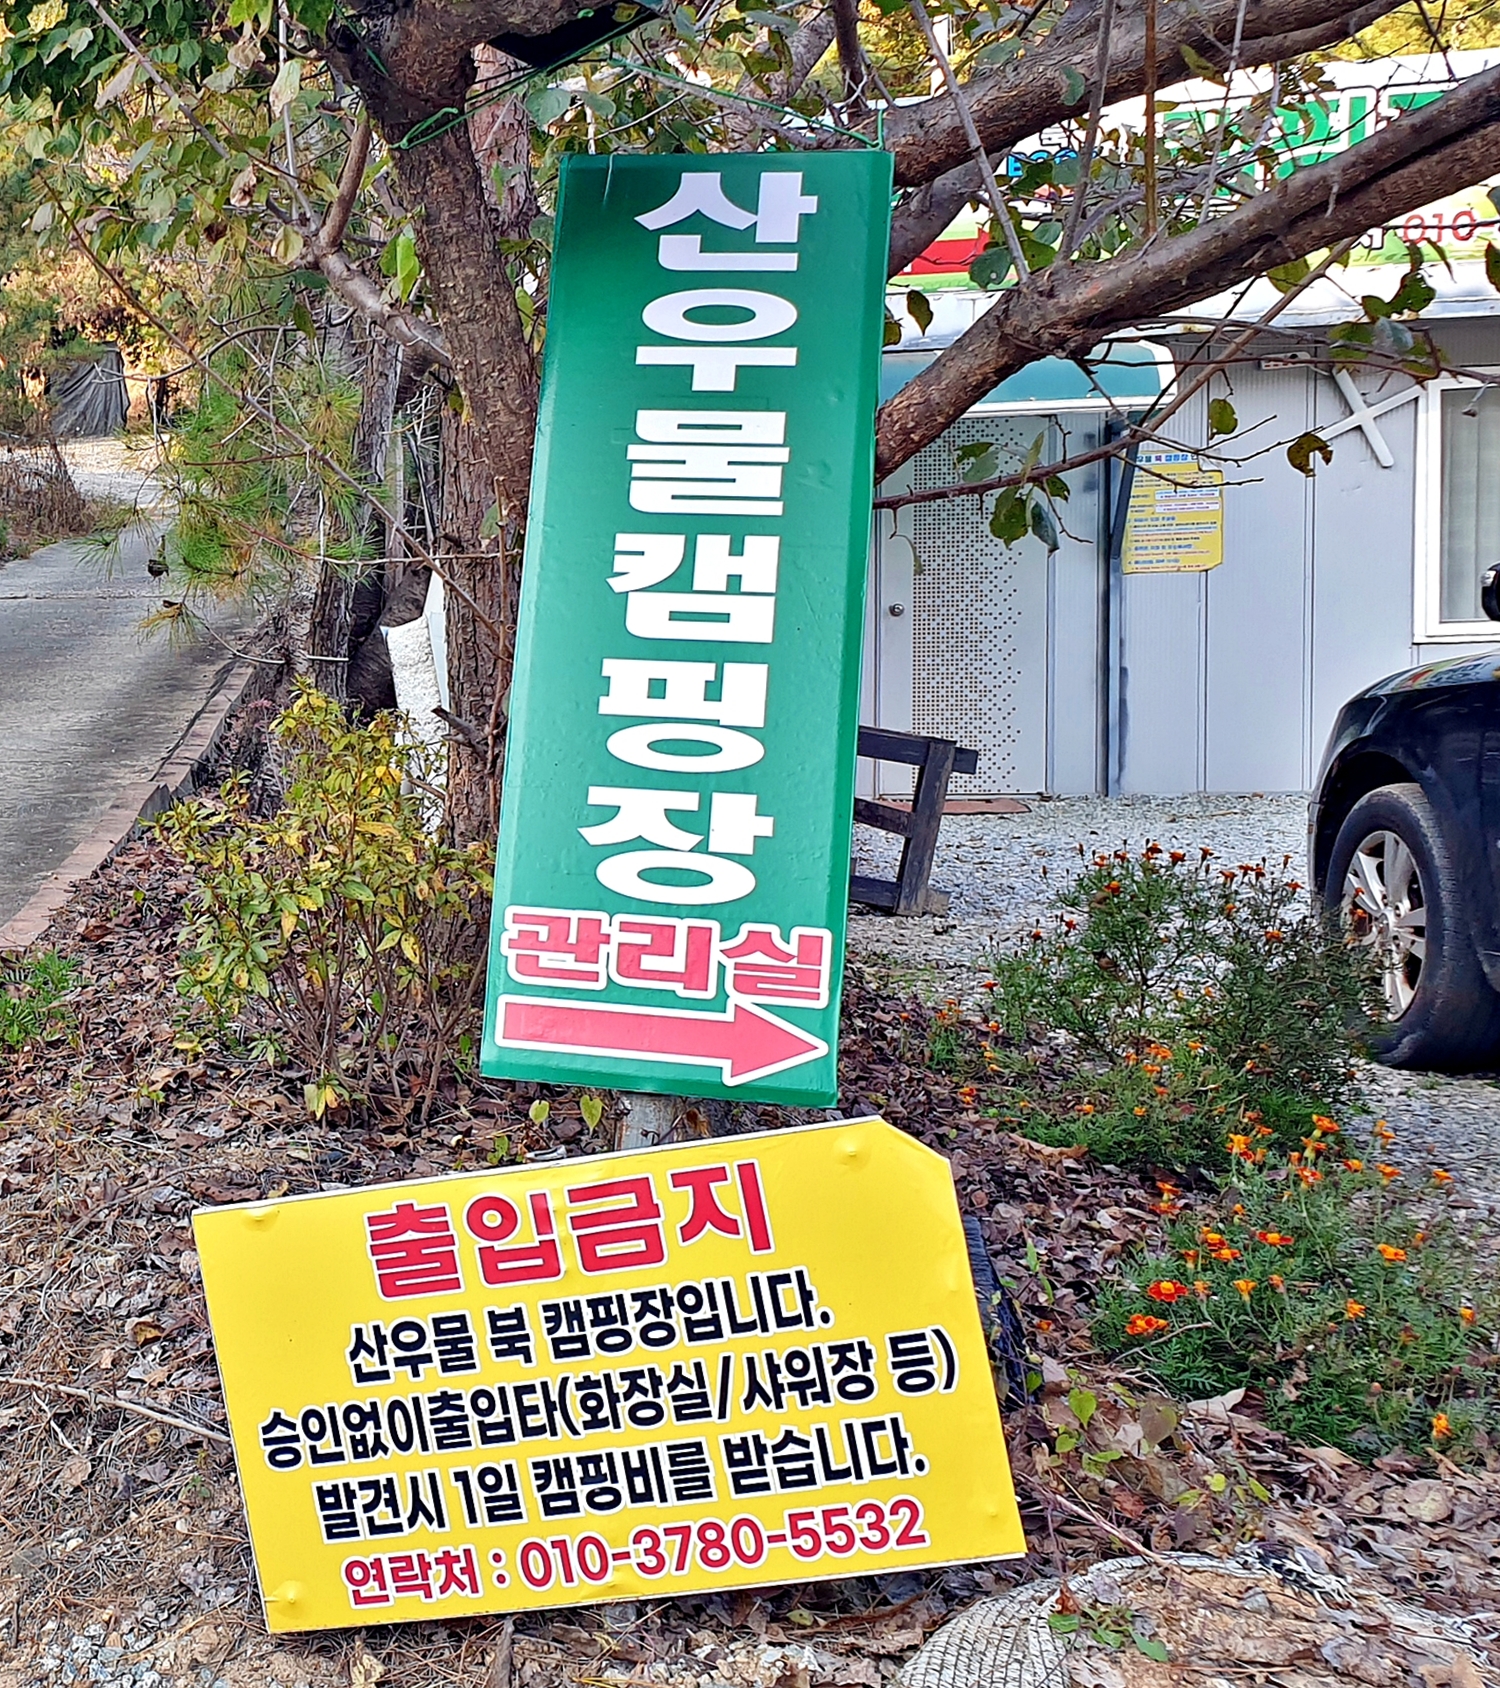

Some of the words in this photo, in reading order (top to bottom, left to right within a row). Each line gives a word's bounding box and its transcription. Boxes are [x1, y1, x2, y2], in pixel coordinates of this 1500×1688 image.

[576, 170, 819, 907] 산우물캠핑장
[506, 911, 827, 1003] 관리실
[365, 1160, 772, 1299] 출입금지
[349, 1313, 477, 1384] 산우물
[486, 1306, 533, 1364] 북
[541, 1269, 831, 1360] 캠핑장입니다.
[888, 1328, 957, 1394] 등)
[315, 1476, 447, 1541] 발견시
[453, 1463, 524, 1525] 1일
[531, 1440, 714, 1518] 캠핑비를
[722, 1416, 926, 1496] 받습니다.
[344, 1548, 480, 1606] 연락처
[519, 1498, 927, 1588] 010-3780-5532
